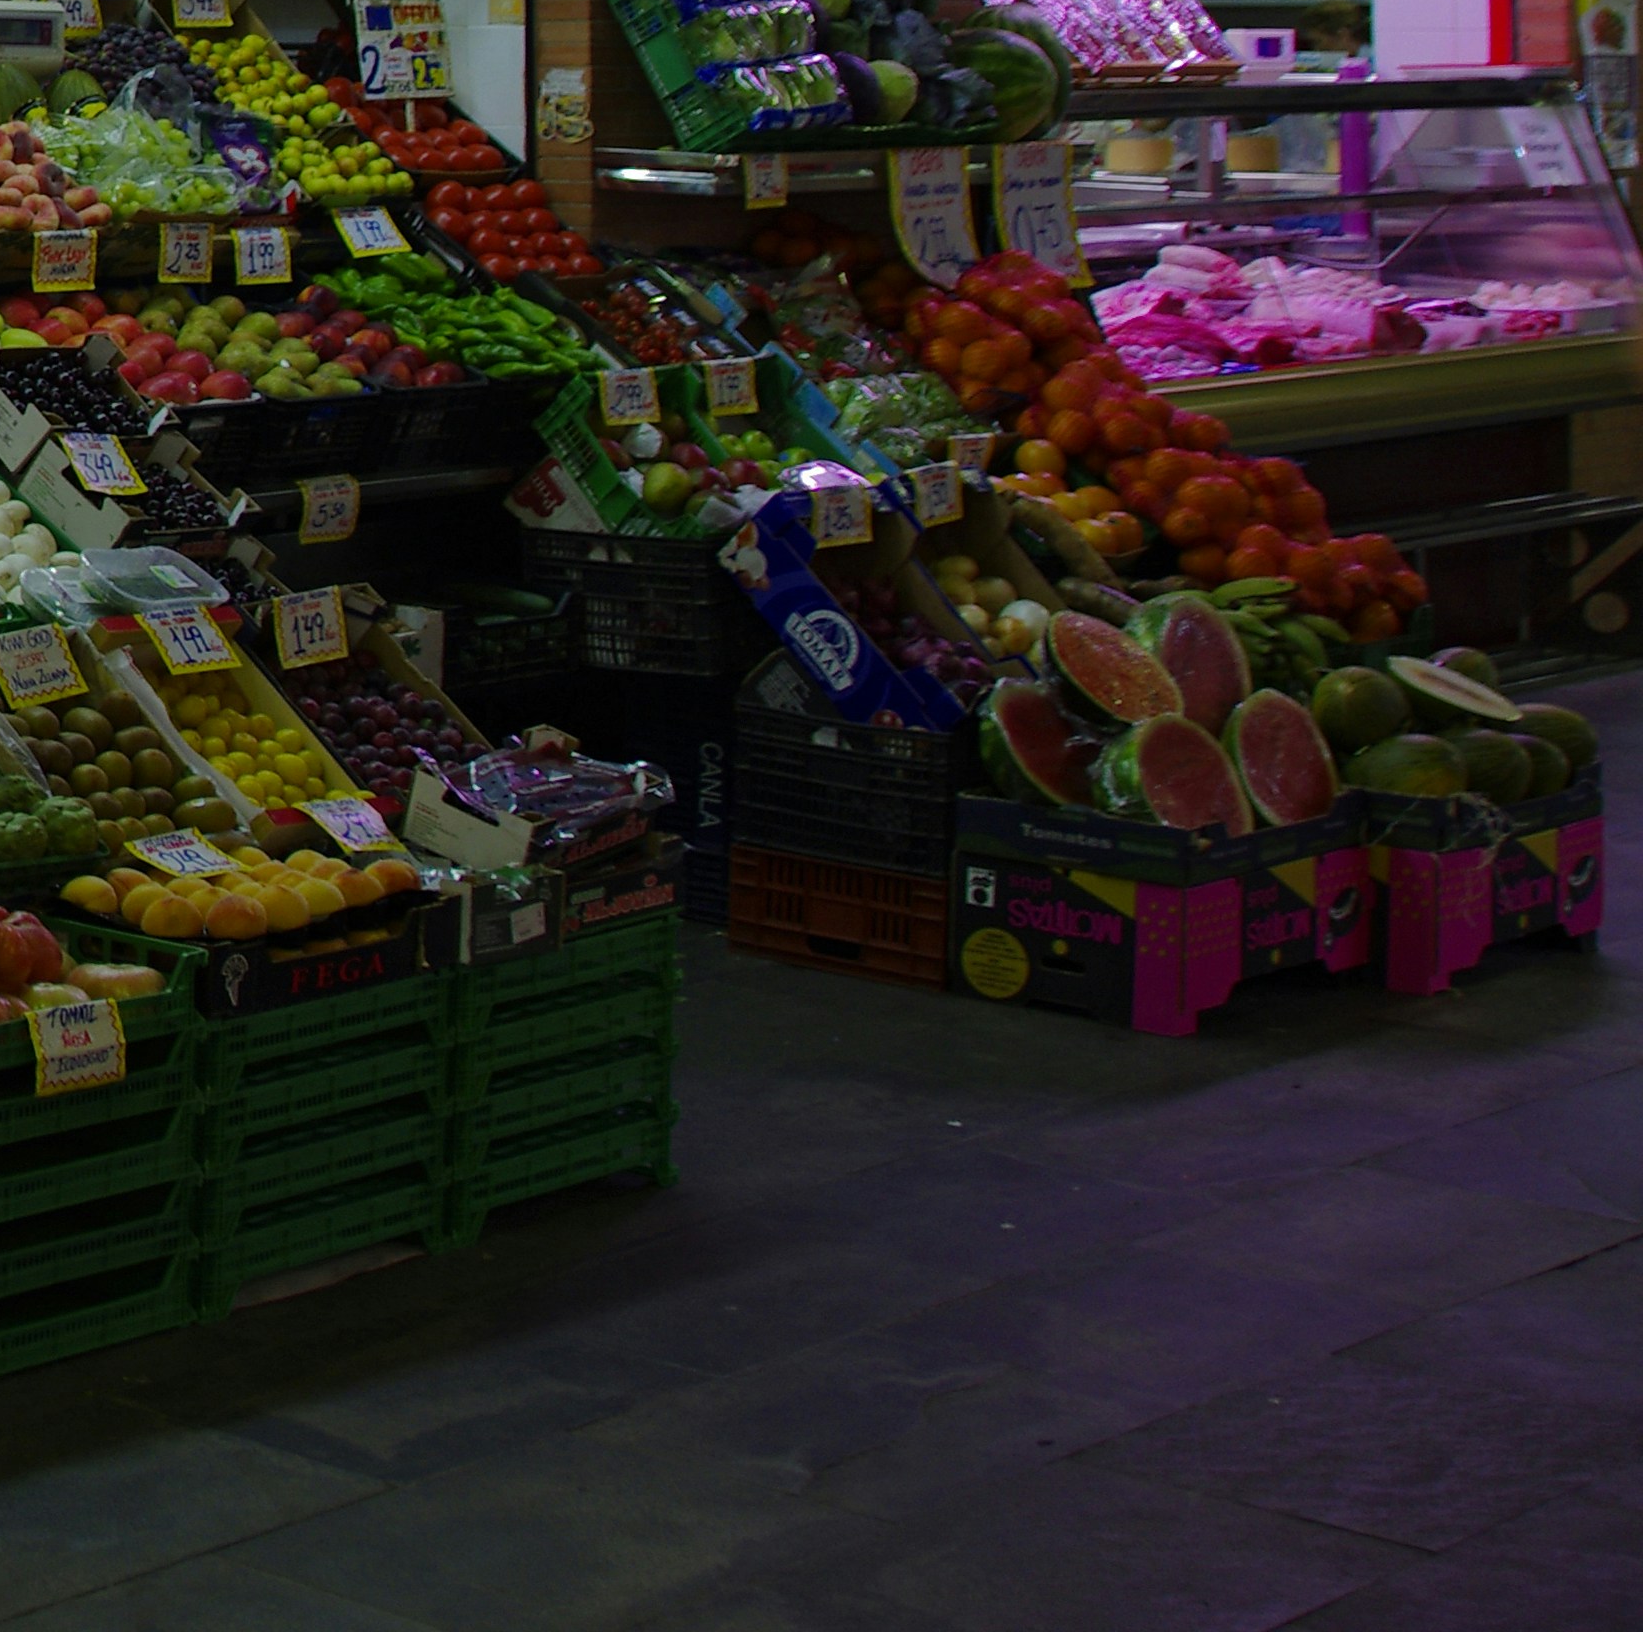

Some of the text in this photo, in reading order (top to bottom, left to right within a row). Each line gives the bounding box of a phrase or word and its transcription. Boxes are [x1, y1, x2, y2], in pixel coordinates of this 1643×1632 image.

[361, 45, 386, 95] 2
[697, 741, 724, 829] CANLA
[292, 952, 385, 994] FEGA
